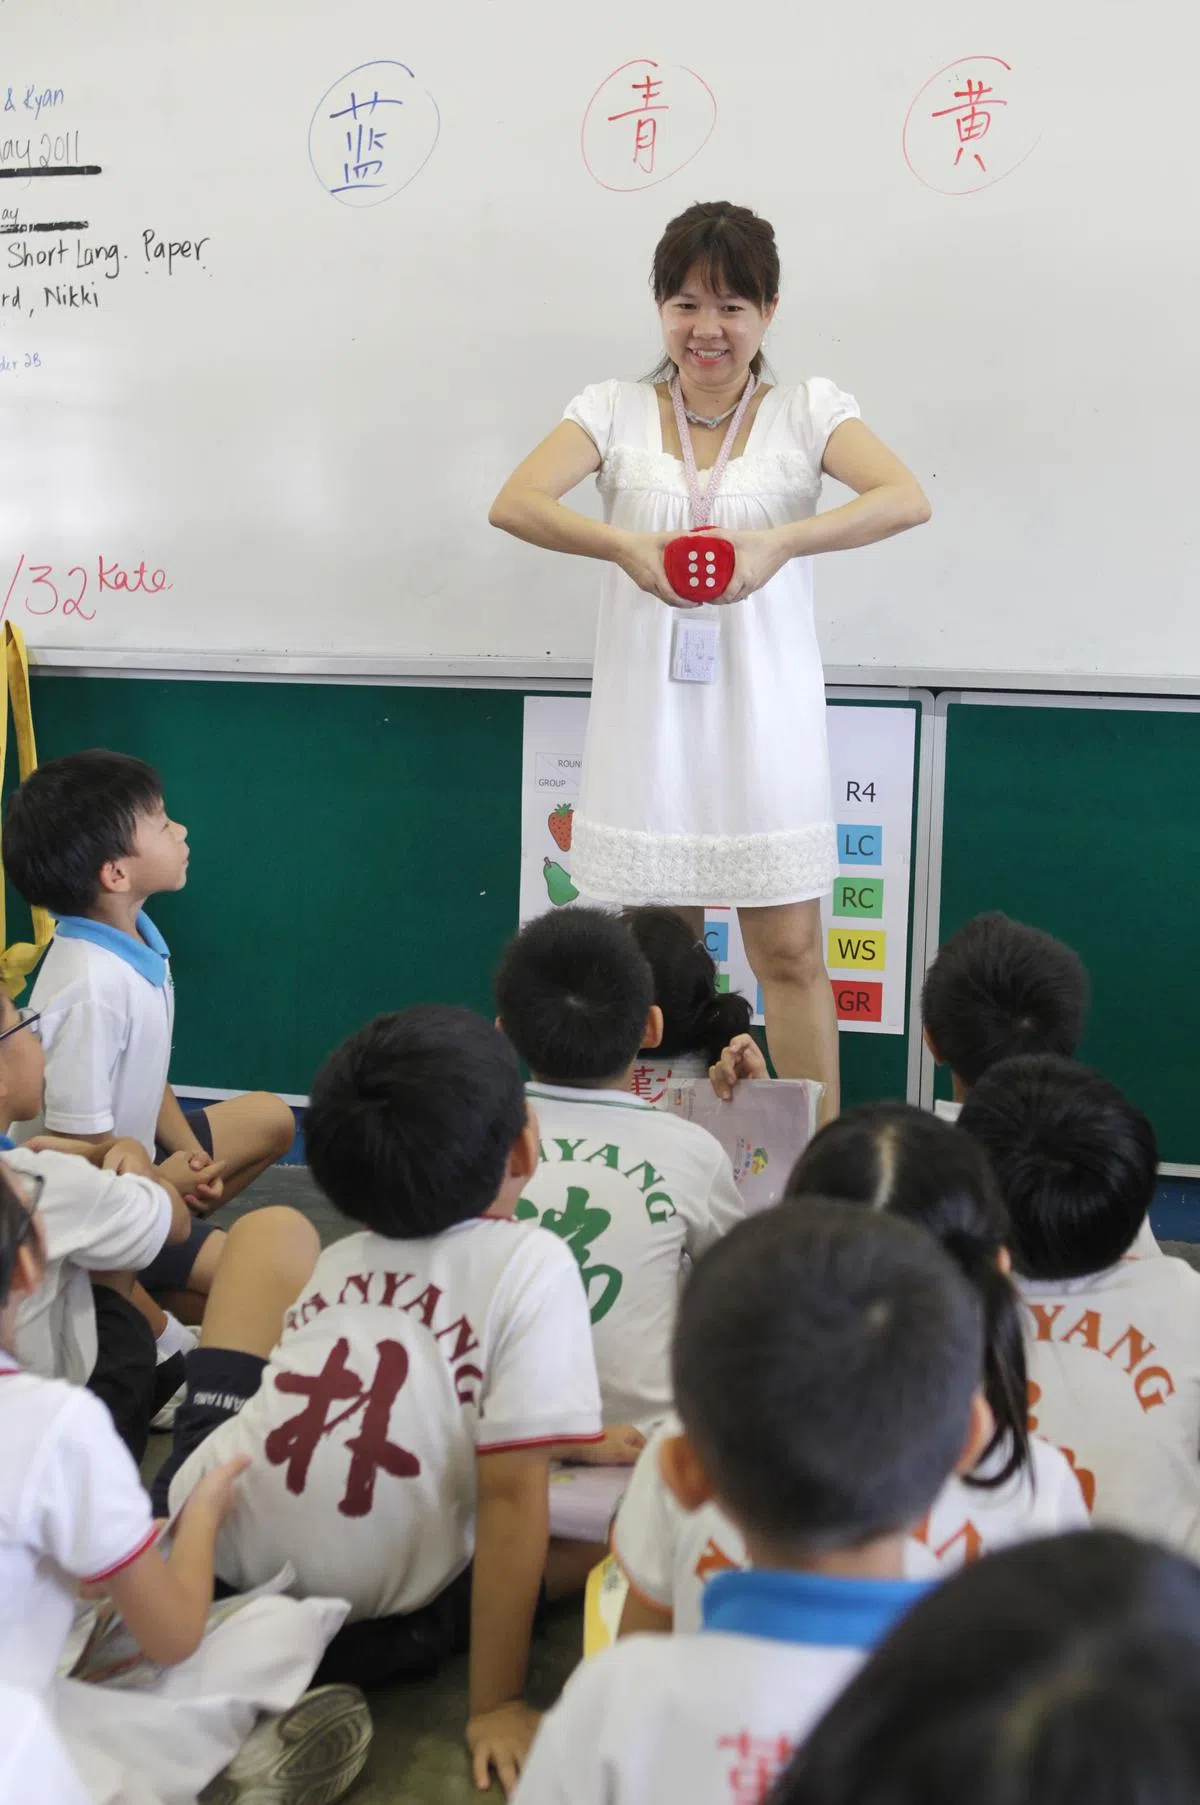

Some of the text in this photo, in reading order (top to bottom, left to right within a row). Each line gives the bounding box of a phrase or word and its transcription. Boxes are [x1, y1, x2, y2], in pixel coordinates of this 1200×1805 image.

[608, 75, 670, 174] 青
[931, 78, 1008, 173] 黄
[39, 130, 79, 168] 2011
[329, 91, 403, 194] 蓝
[7, 239, 69, 269] Short
[43, 281, 99, 308] Nikki
[558, 759, 583, 769] ROUN
[538, 778, 566, 788] GROUP
[846, 780, 877, 803] R4
[844, 834, 875, 857] LC
[841, 886, 875, 909] RC
[837, 937, 877, 961] WS
[837, 990, 872, 1012] GR
